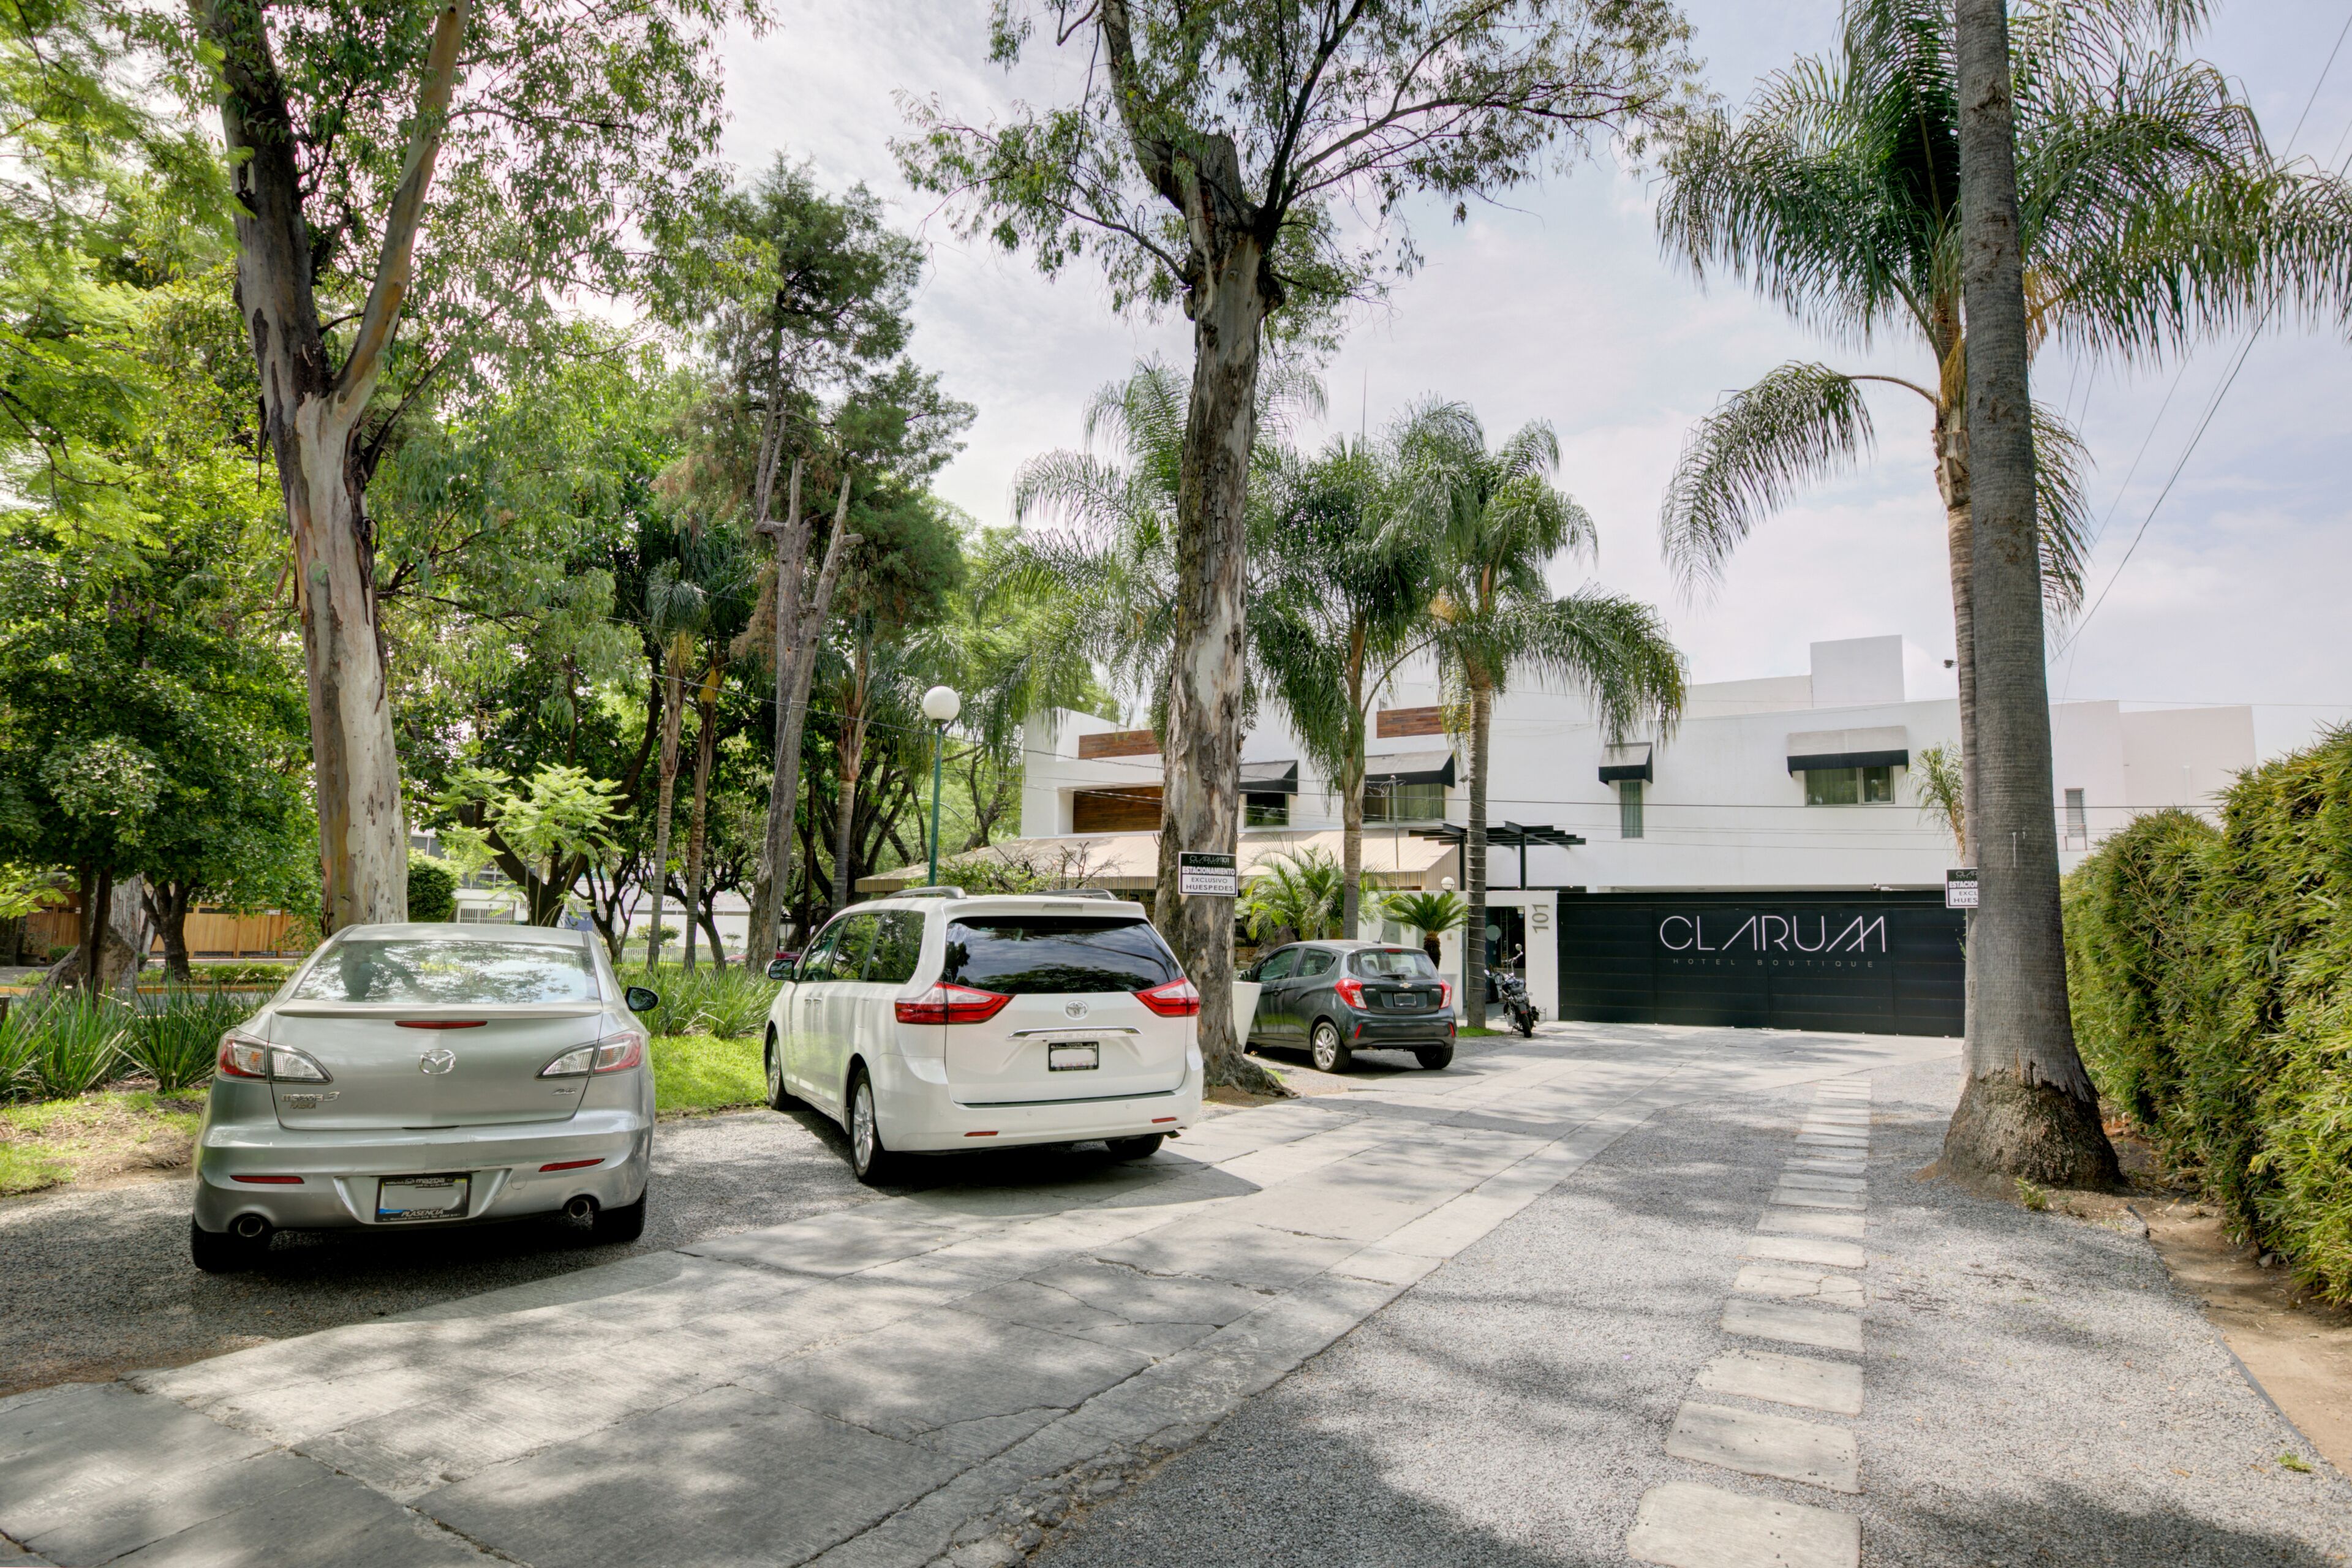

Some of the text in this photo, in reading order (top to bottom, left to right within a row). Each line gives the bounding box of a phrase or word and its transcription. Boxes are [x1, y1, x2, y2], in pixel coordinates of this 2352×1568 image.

[1182, 866, 1235, 876] ESTACIONAMIENTO
[1532, 904, 1548, 933] 101
[1660, 915, 1886, 952] CLARUM
[1757, 959, 1873, 968] BOUTIQUE
